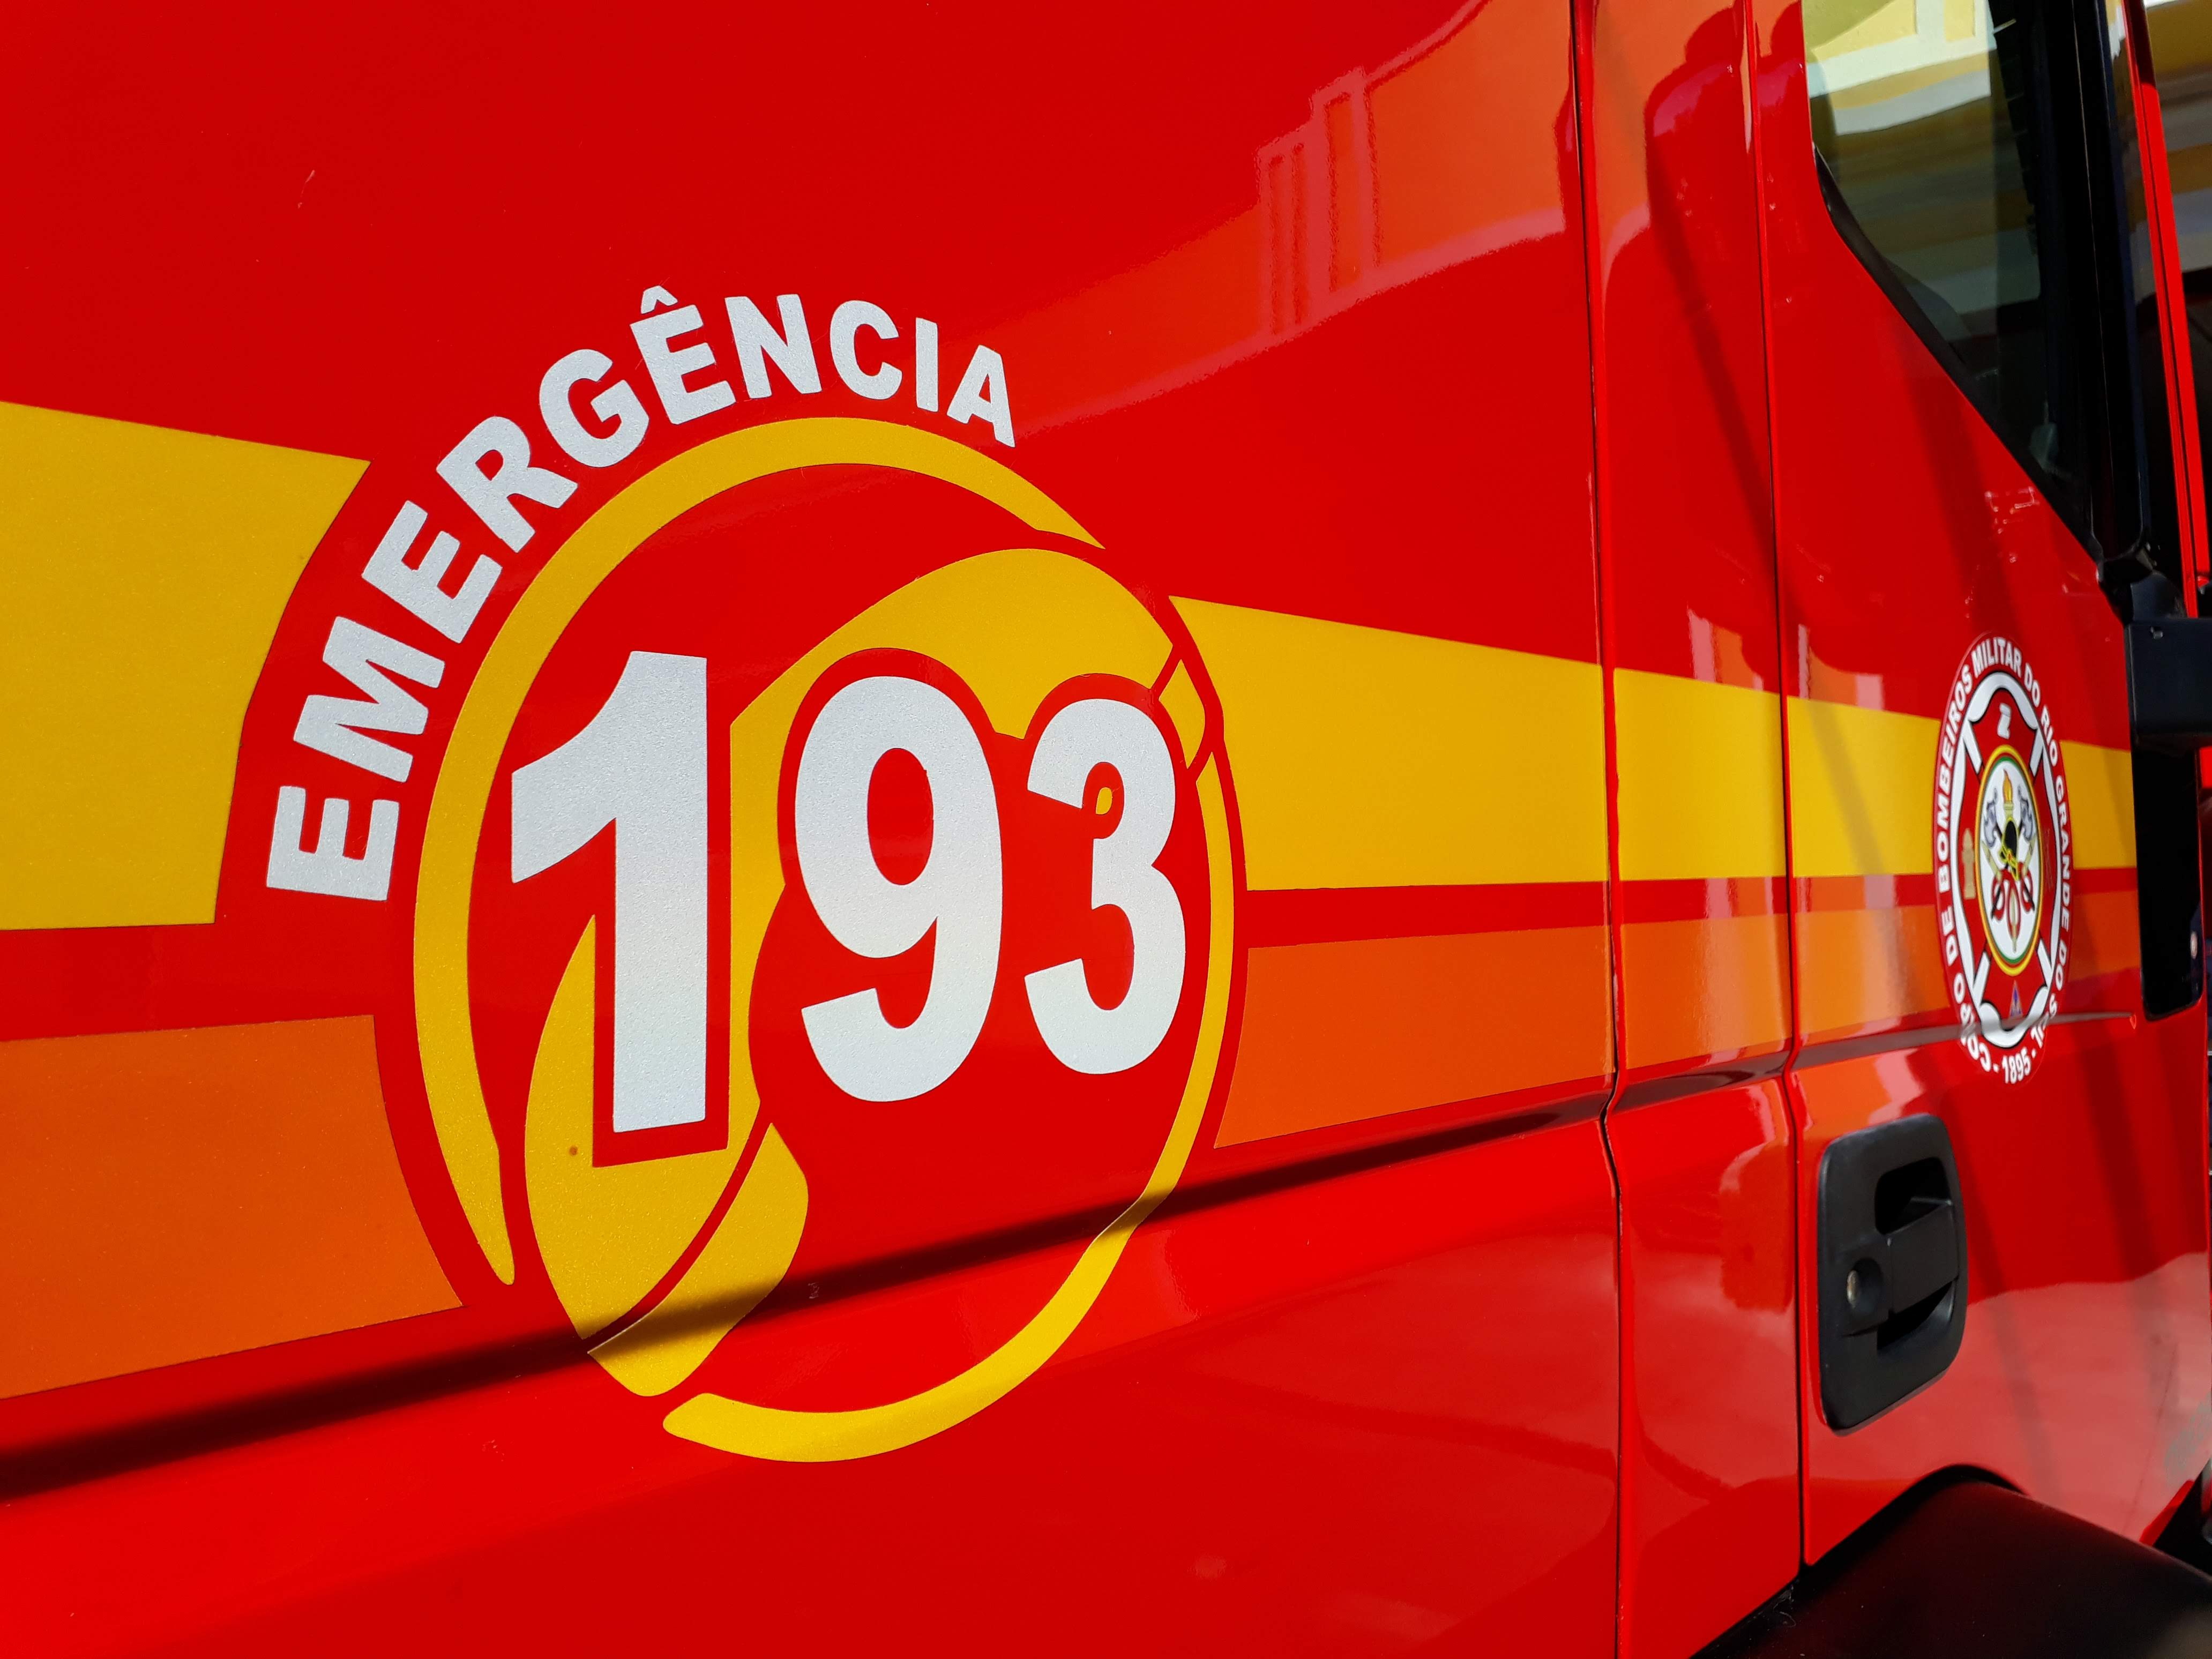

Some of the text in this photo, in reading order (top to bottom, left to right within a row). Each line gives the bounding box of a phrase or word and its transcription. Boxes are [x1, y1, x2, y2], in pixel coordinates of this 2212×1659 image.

[266, 285, 1015, 901] EMERGÊNCIA
[1971, 637, 2022, 678] MILITAR
[2023, 662, 2041, 708] DO
[2041, 704, 2058, 767] RIO
[1937, 664, 1973, 893] BOMBEIROS
[511, 651, 1186, 1102] 193
[2056, 775, 2071, 932] GRANDE
[1940, 906, 1959, 966] DE
[2055, 939, 2068, 991] DO
[2001, 1047, 2031, 1085] 1895
